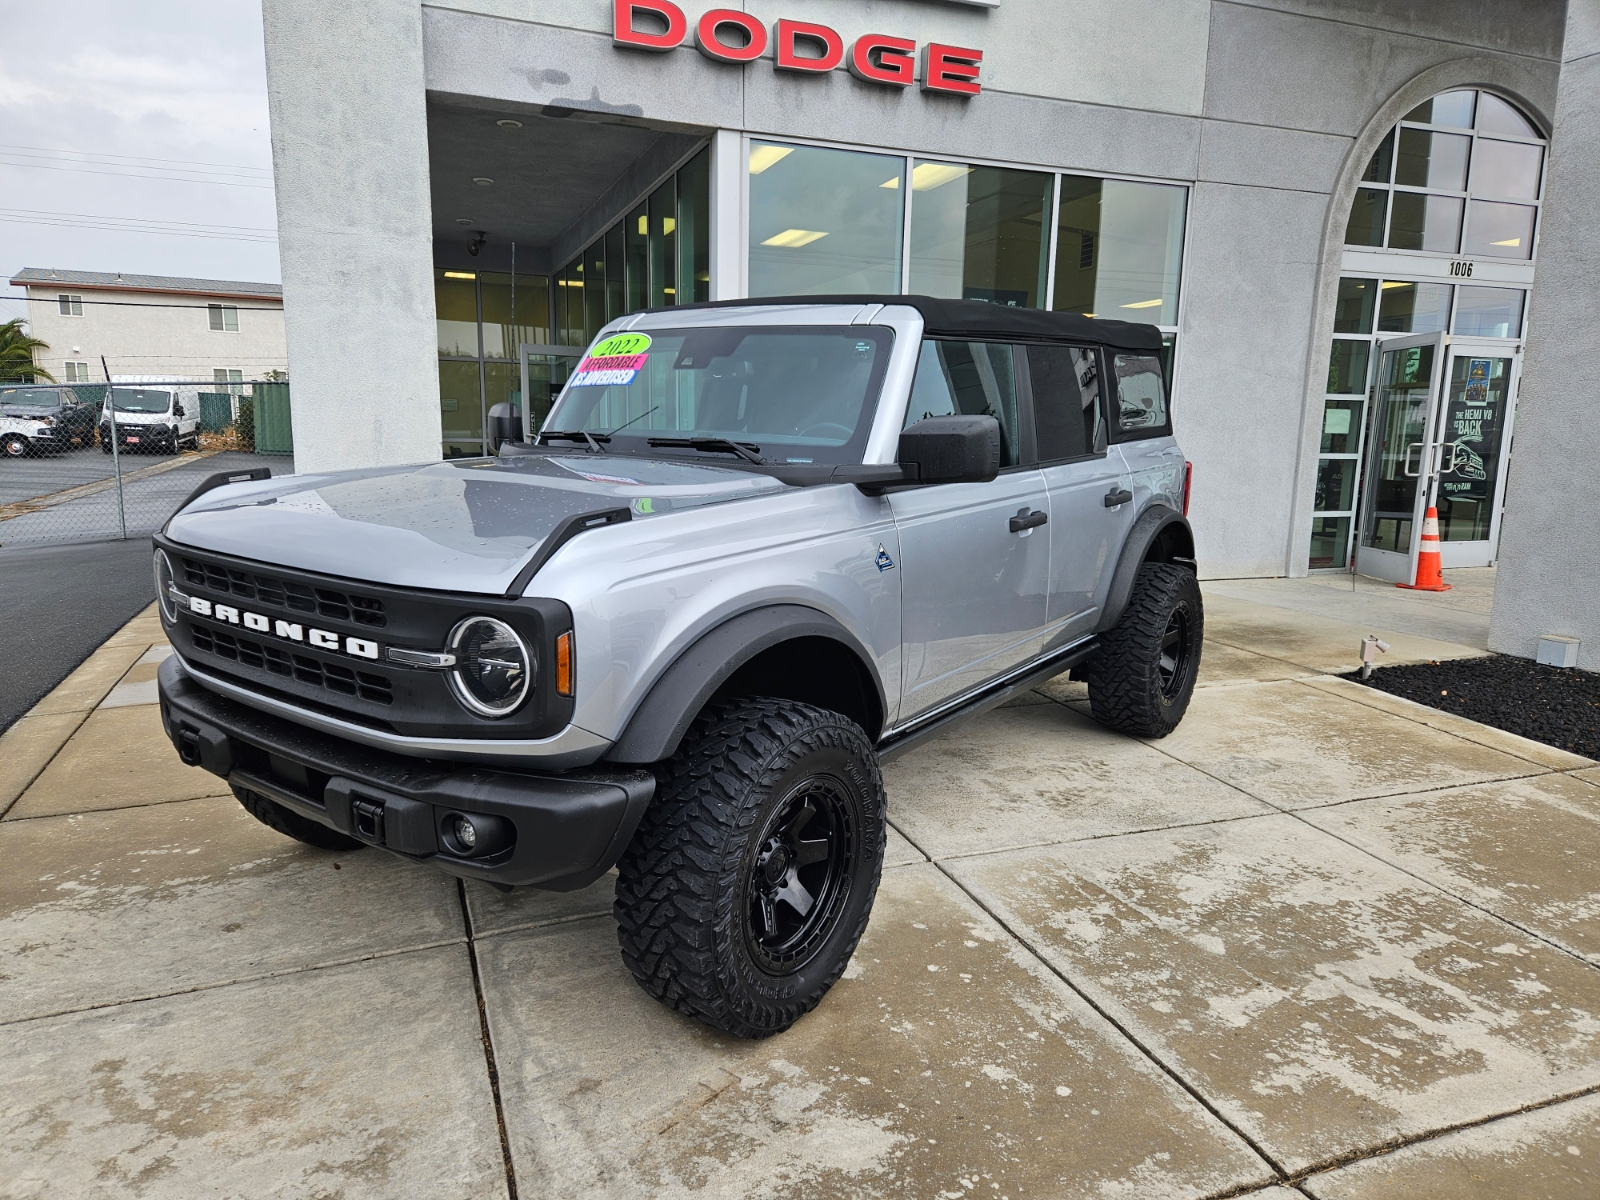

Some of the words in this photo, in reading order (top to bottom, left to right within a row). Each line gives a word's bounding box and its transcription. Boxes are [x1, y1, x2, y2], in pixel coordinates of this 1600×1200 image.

[613, 0, 983, 97] DODGE
[1450, 261, 1473, 277] 1006
[599, 338, 640, 356] 2022
[583, 355, 641, 371] AFFORDABLE
[571, 371, 587, 387] AS
[581, 370, 635, 386] ADVERTISED
[1455, 411, 1464, 419] THE
[1464, 409, 1482, 419] HEMI
[1483, 409, 1492, 420] V8
[1458, 420, 1482, 435] BACK
[190, 596, 378, 659] BRONCO
